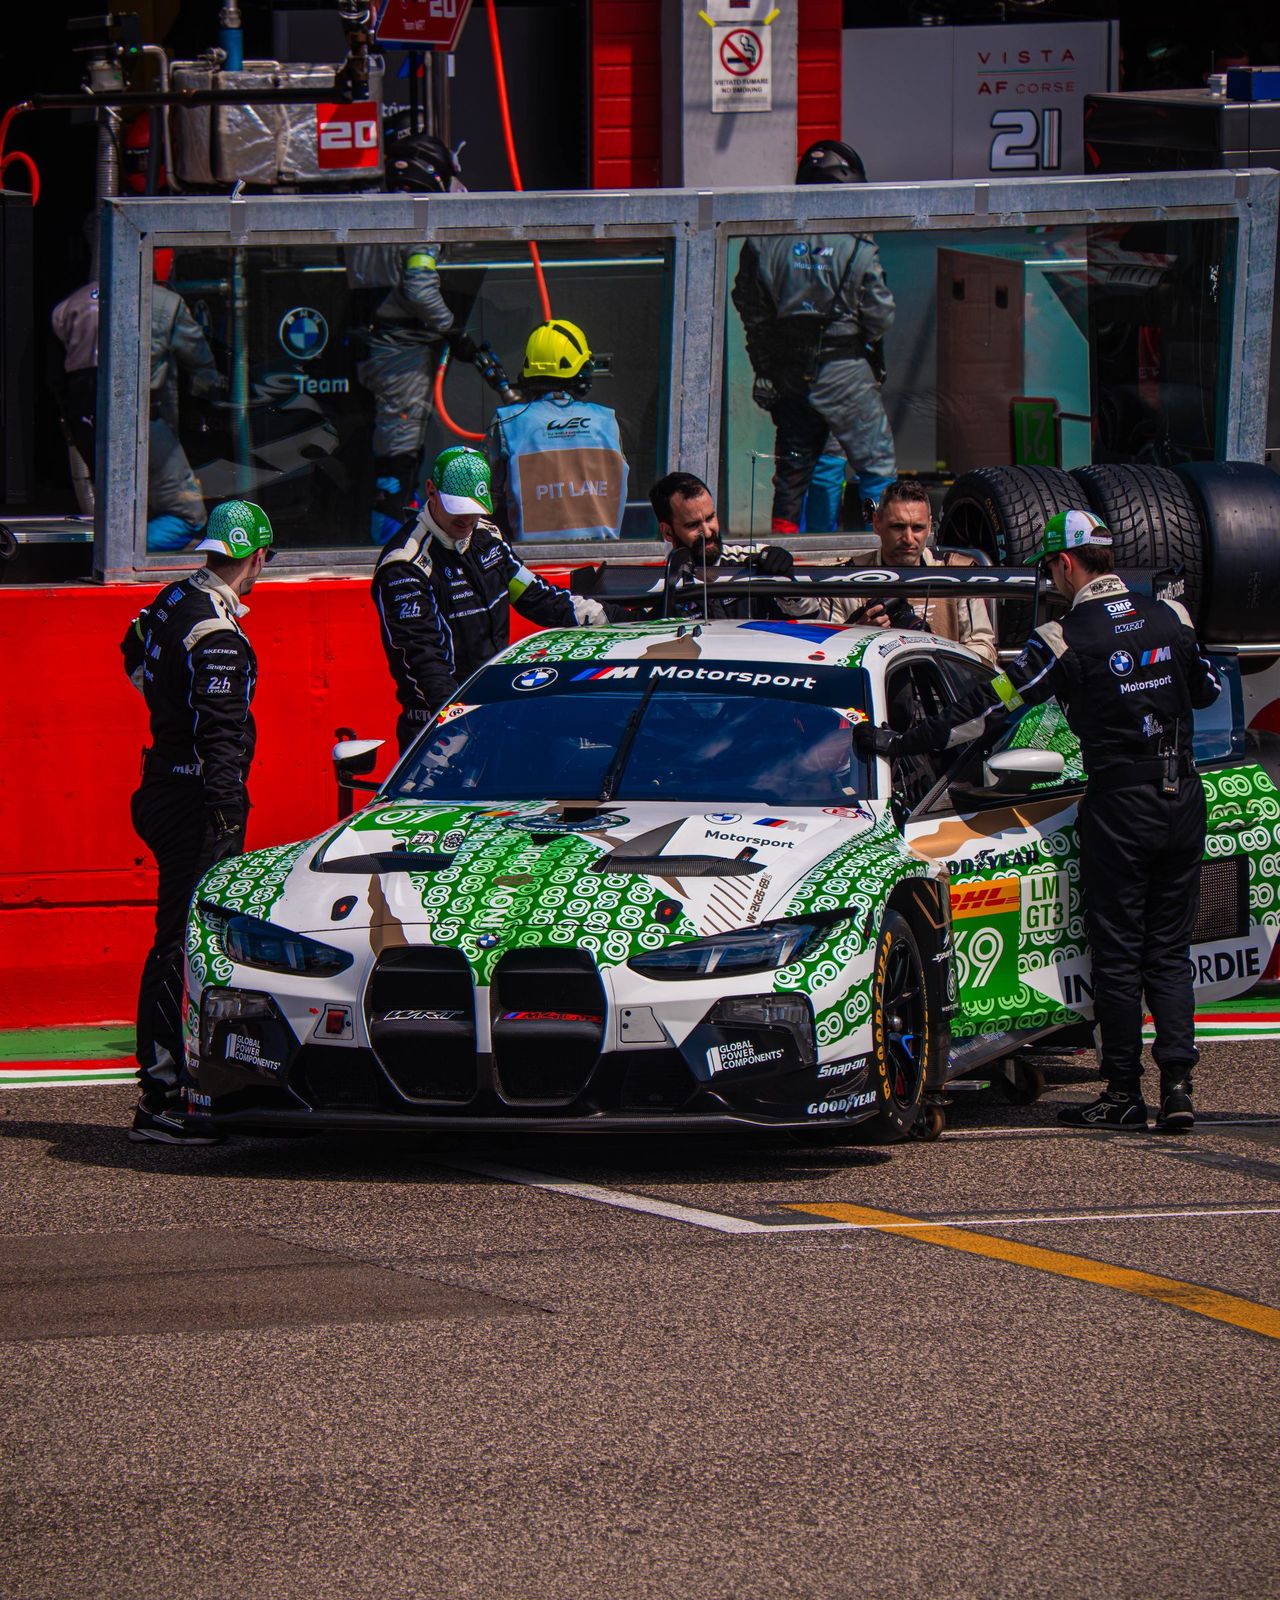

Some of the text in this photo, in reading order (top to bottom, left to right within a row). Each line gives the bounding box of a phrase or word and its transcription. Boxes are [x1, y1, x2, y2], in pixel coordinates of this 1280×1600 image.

[978, 50, 1075, 64] VISTA
[978, 81, 1075, 95] AF CORSE
[320, 121, 378, 149] 20
[990, 108, 1060, 171] 21
[298, 376, 349, 394] Team
[547, 417, 591, 430] WEC
[536, 480, 607, 500] PIT LANE
[1107, 601, 1132, 612] OMP
[1115, 619, 1145, 634] WRT
[206, 663, 236, 671] Snap-on
[208, 676, 231, 690] 24h
[649, 665, 817, 692] Motorsport
[1120, 675, 1172, 694] Motorsport
[705, 830, 794, 849] Motorsport
[1031, 876, 1060, 901] LM
[951, 887, 1004, 911] DHL
[1026, 902, 1064, 929] GT3
[951, 927, 1004, 989] 69
[236, 1044, 260, 1057] POWER
[237, 1035, 261, 1049] GLOBAL
[720, 1040, 754, 1054] GLOBAL
[721, 1048, 755, 1062] POWER
[817, 1057, 867, 1079] Snap-on
[807, 1090, 877, 1114] GOODYEAR
